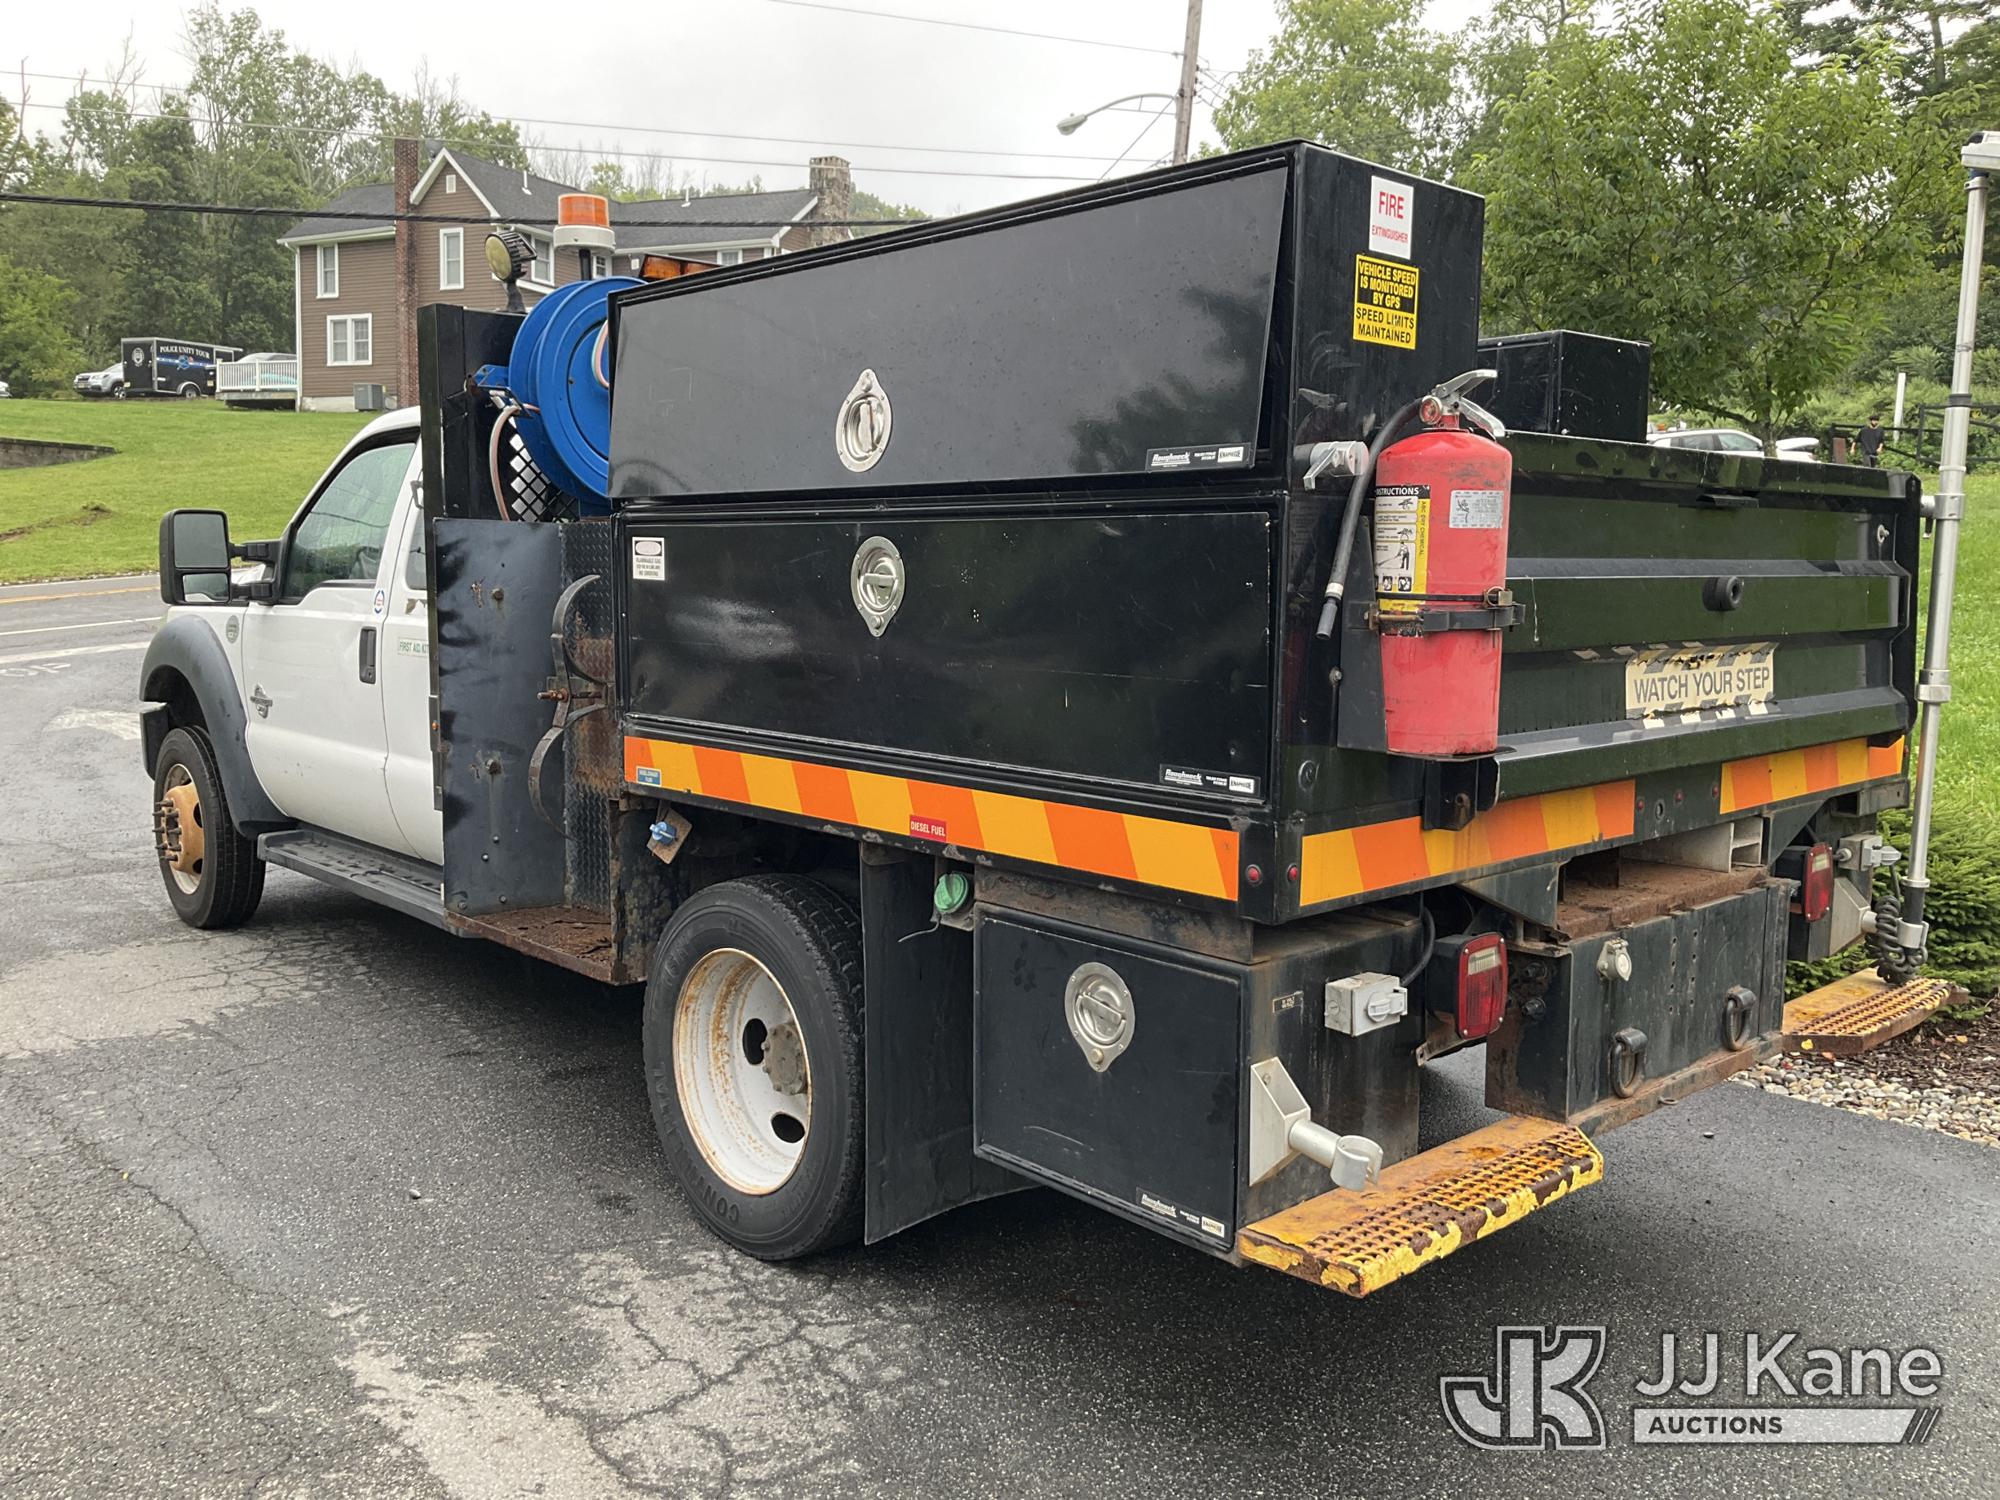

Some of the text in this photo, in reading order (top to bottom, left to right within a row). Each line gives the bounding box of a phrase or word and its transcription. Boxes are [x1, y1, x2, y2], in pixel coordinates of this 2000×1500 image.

[1378, 191, 1405, 220] FIRE
[1371, 224, 1409, 244] EXTINGUISHER
[1358, 260, 1416, 286] VEHICLE SPEED
[1360, 275, 1414, 299] IS MONITORED
[1372, 291, 1401, 309] BY GPS
[1356, 307, 1415, 330] SPEED LIMITS
[1358, 324, 1411, 344] MAINTAINED
[160, 345, 210, 359] POLICE UNITY TOUR
[400, 641, 412, 652] FIRST
[1633, 666, 1770, 704] WATCH YOUR STEP
[910, 821, 946, 837] DIESEL FUEL
